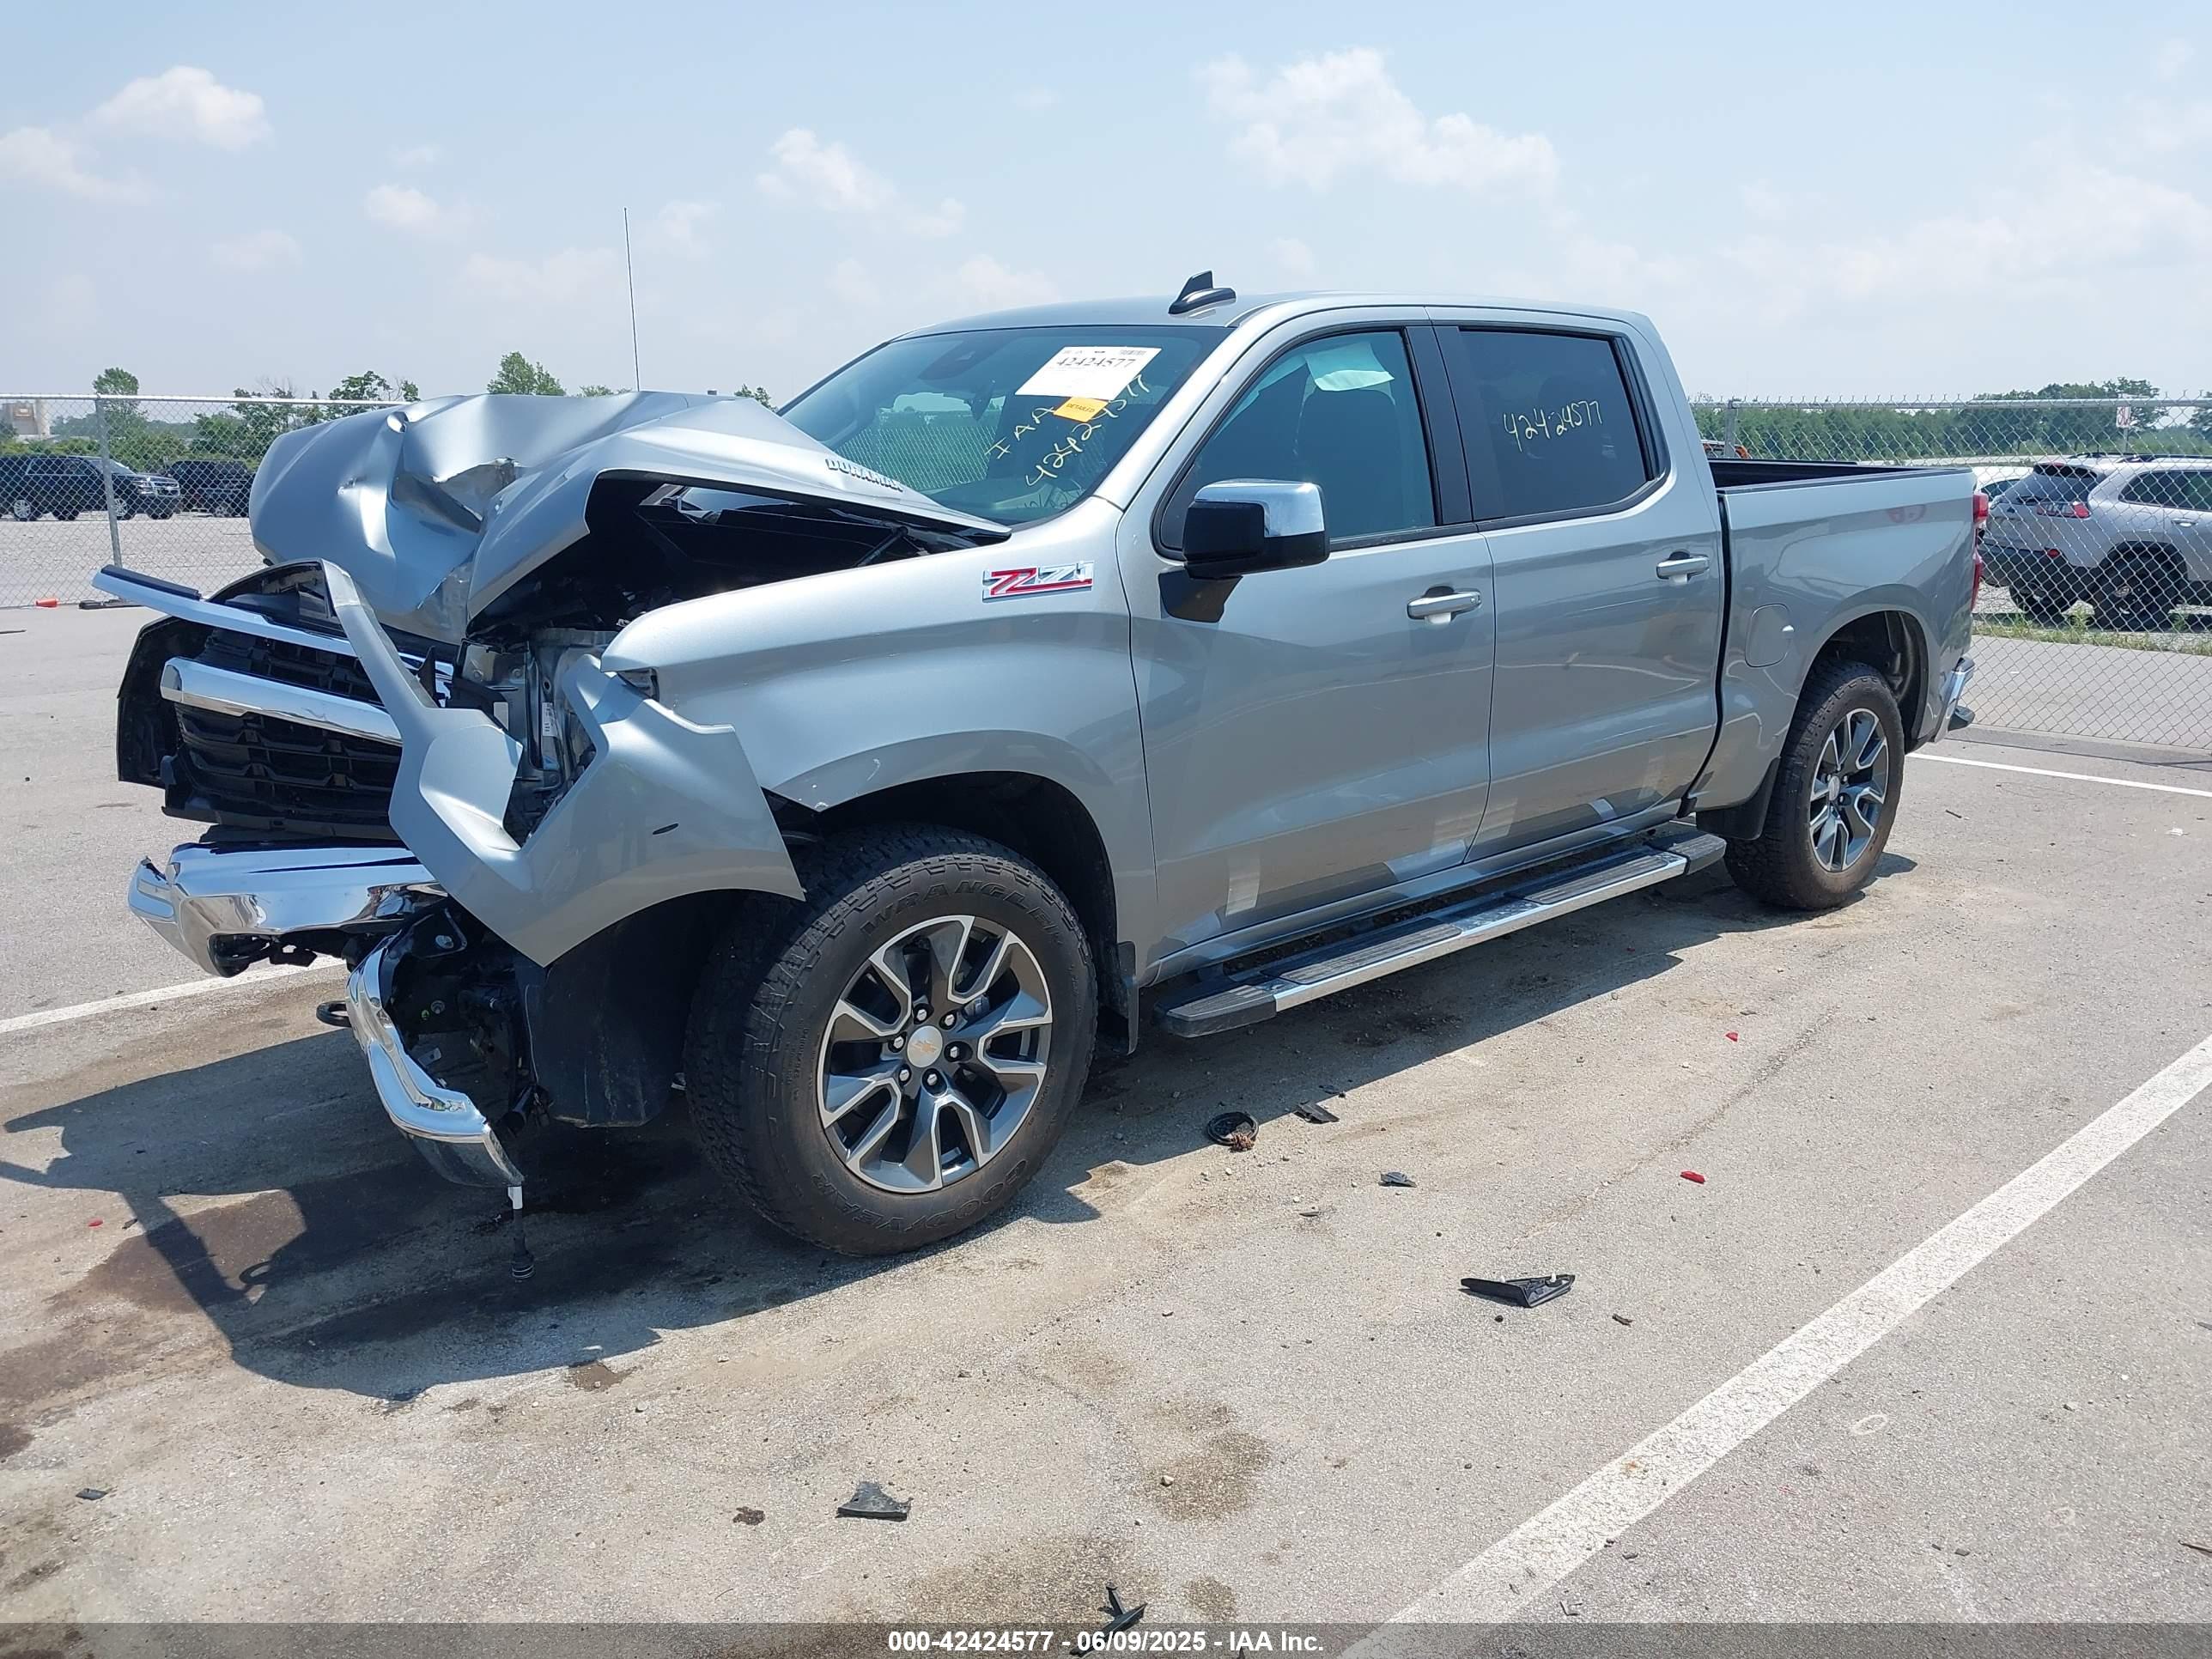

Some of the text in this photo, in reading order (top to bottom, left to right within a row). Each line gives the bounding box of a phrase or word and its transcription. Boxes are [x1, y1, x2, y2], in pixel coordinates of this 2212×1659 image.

[1056, 356, 1137, 368] 42424577
[1066, 403, 1096, 413] DETAILED
[1503, 399, 1603, 453] 42424577
[981, 560, 1095, 603] Z71
[859, 880, 1065, 945] WRANGLER
